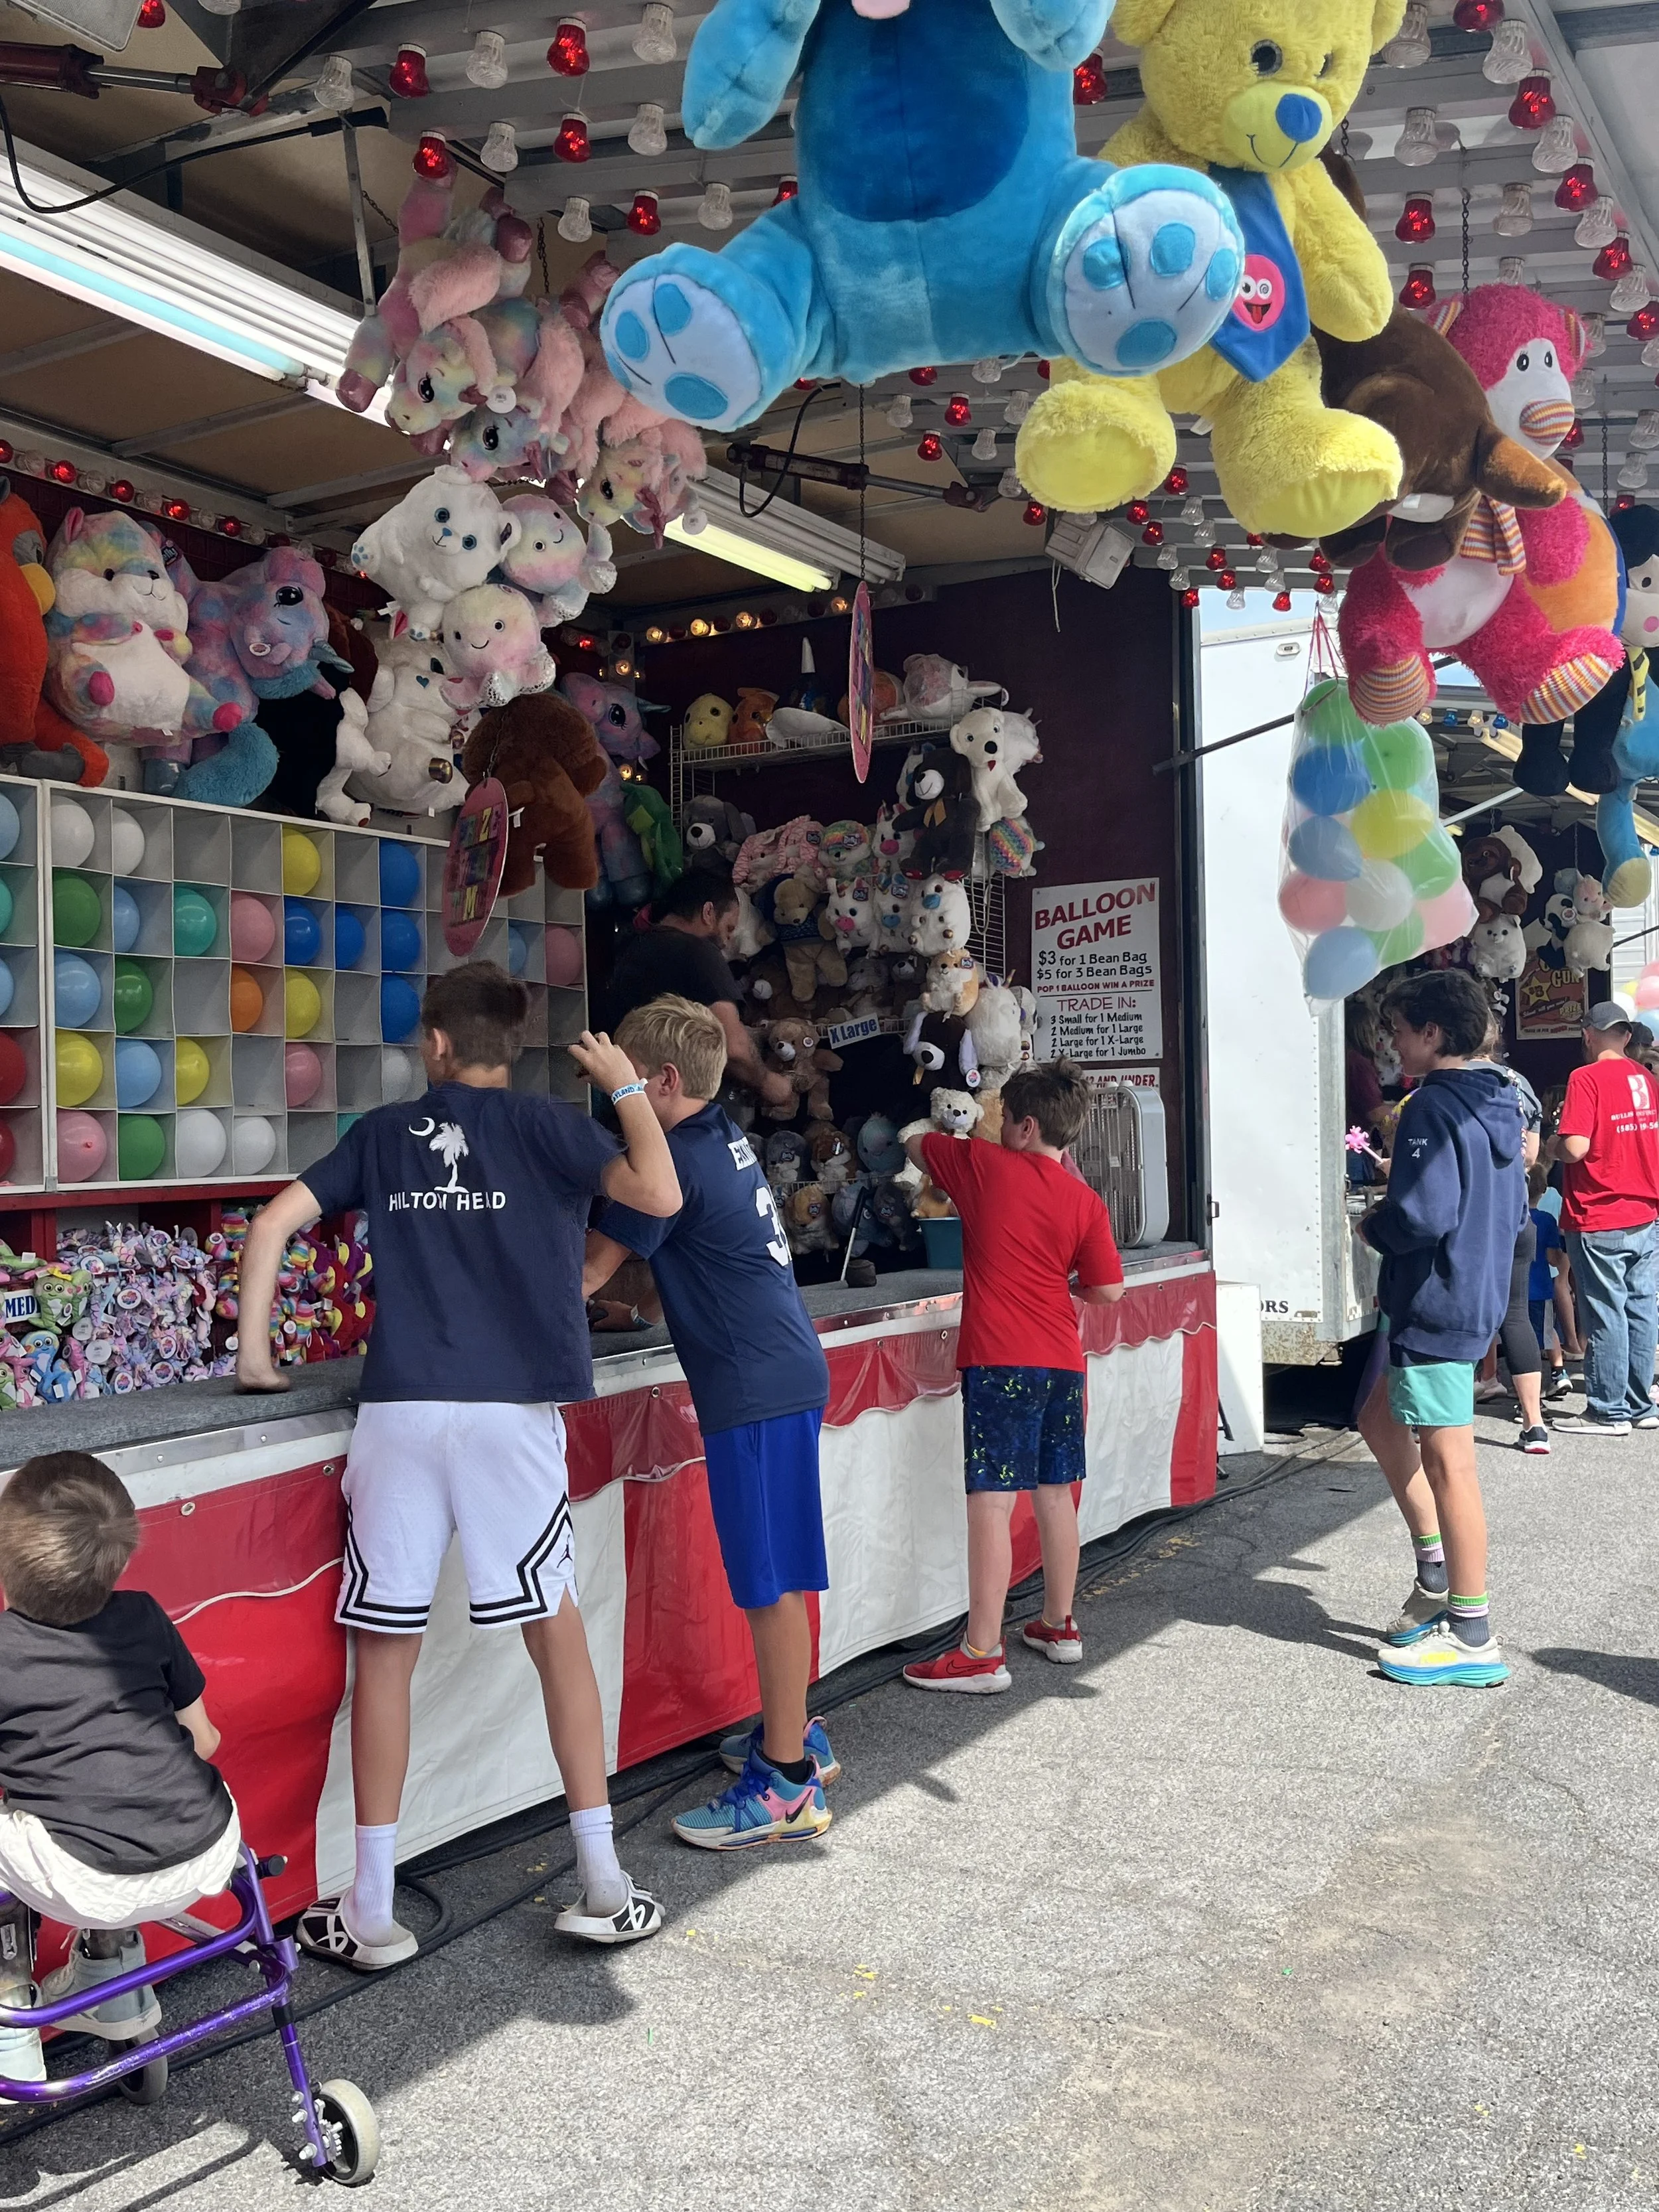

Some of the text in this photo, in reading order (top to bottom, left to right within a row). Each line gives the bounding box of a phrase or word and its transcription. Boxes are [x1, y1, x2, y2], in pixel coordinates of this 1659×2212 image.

[1035, 881, 1156, 930] BALLOON
[1056, 915, 1132, 950] GAME
[1039, 950, 1147, 966] $3 for 1 Bean Bag
[1037, 965, 1152, 980] $5 for 3 Bean Bags
[1062, 983, 1100, 992] BALLOON
[1056, 996, 1136, 1011] TRADE IN:
[1050, 1012, 1143, 1025] 3 Small for 1 Medium
[830, 1018, 878, 1044] X Large
[1051, 1023, 1143, 1036] 2 Medium for 1 Large
[1051, 1035, 1144, 1047] 2 Large for 1 X-Large
[1050, 1049, 1056, 1059] 2
[1096, 1047, 1109, 1057] for
[1111, 1047, 1116, 1056] 1
[1118, 1046, 1146, 1056] Jumbo
[1121, 1074, 1156, 1087] UNDER
[1407, 1138, 1428, 1146] TANK
[1411, 1147, 1420, 1158] 4
[388, 1192, 447, 1211] HILTON
[1261, 1300, 1289, 1313] RS
